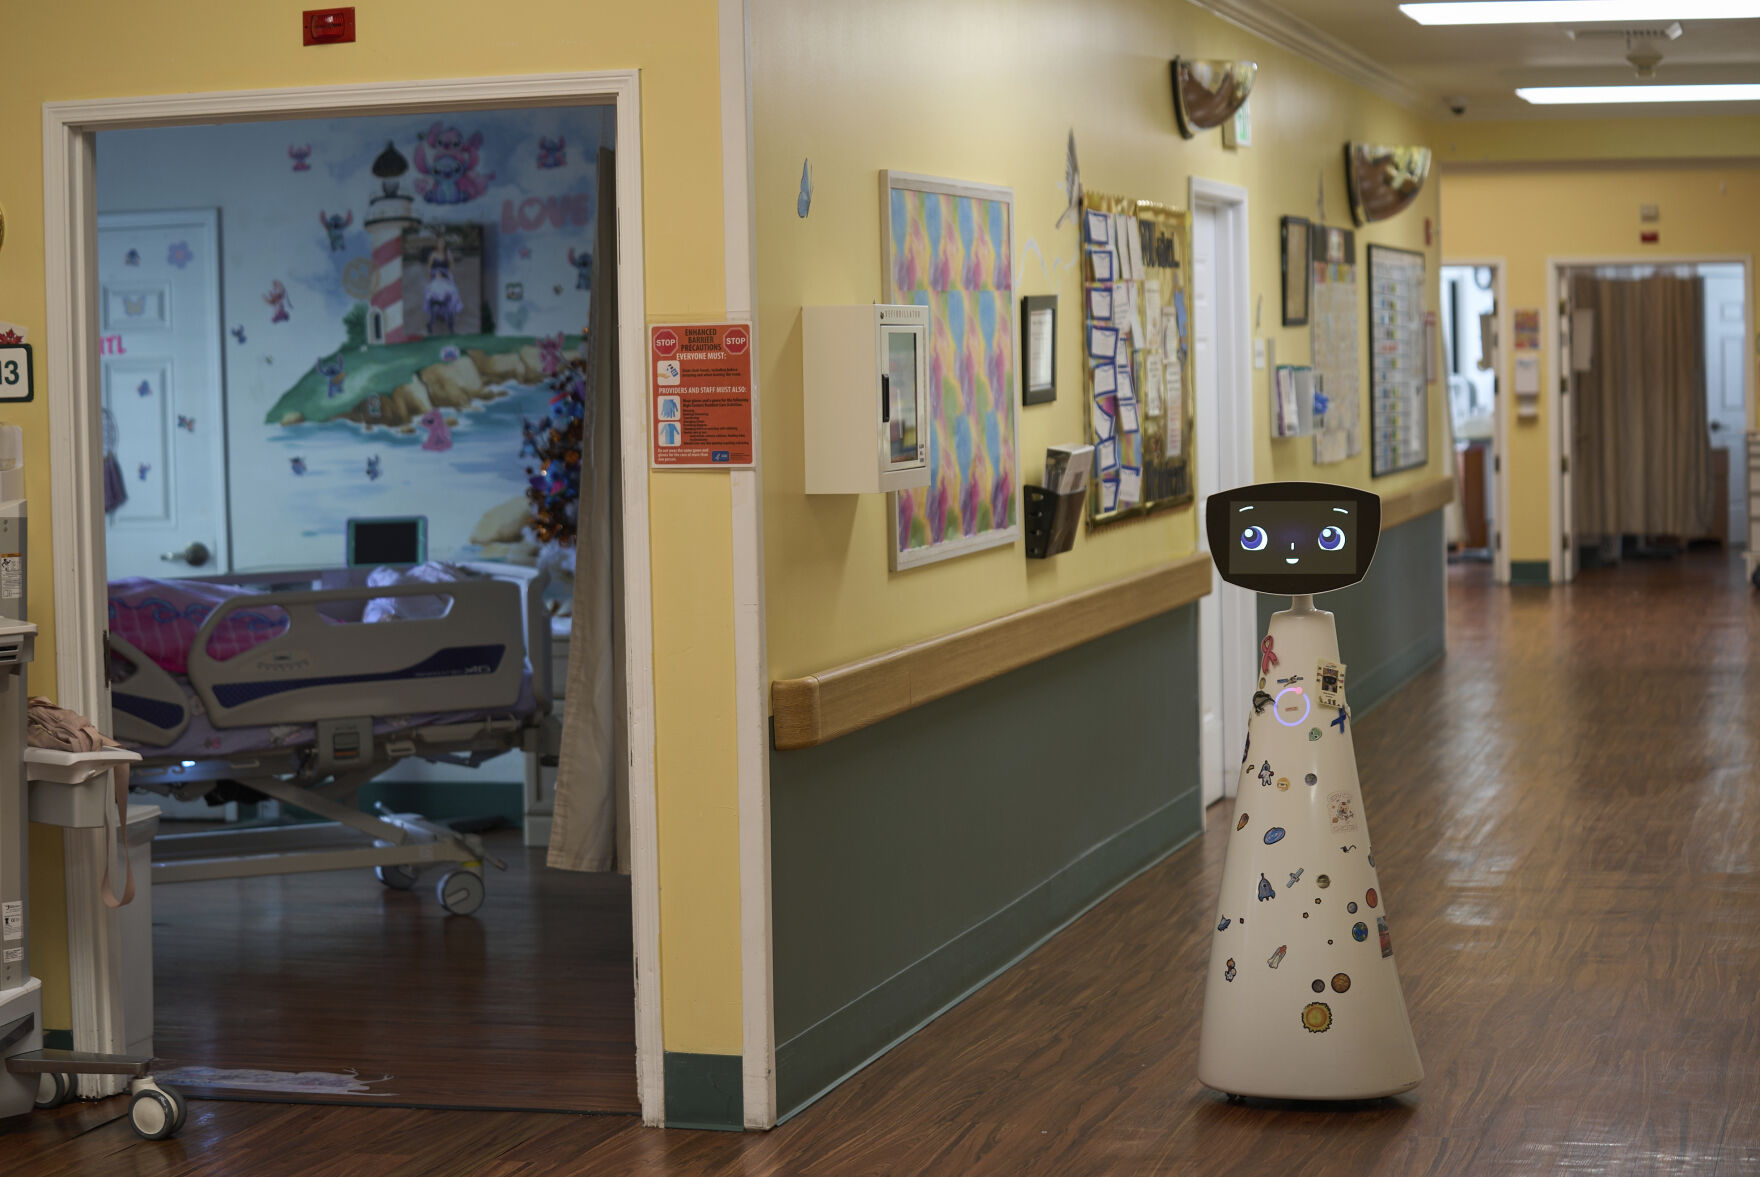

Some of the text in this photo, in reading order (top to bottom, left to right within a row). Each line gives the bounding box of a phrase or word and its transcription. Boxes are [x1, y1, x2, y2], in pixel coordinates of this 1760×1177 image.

[502, 193, 590, 234] LOVE
[685, 328, 717, 336] ENHANCED
[656, 339, 676, 347] STOP
[688, 336, 714, 344] BARRIER
[726, 337, 746, 345] STOP
[676, 352, 727, 360] EVERYONE MUST:
